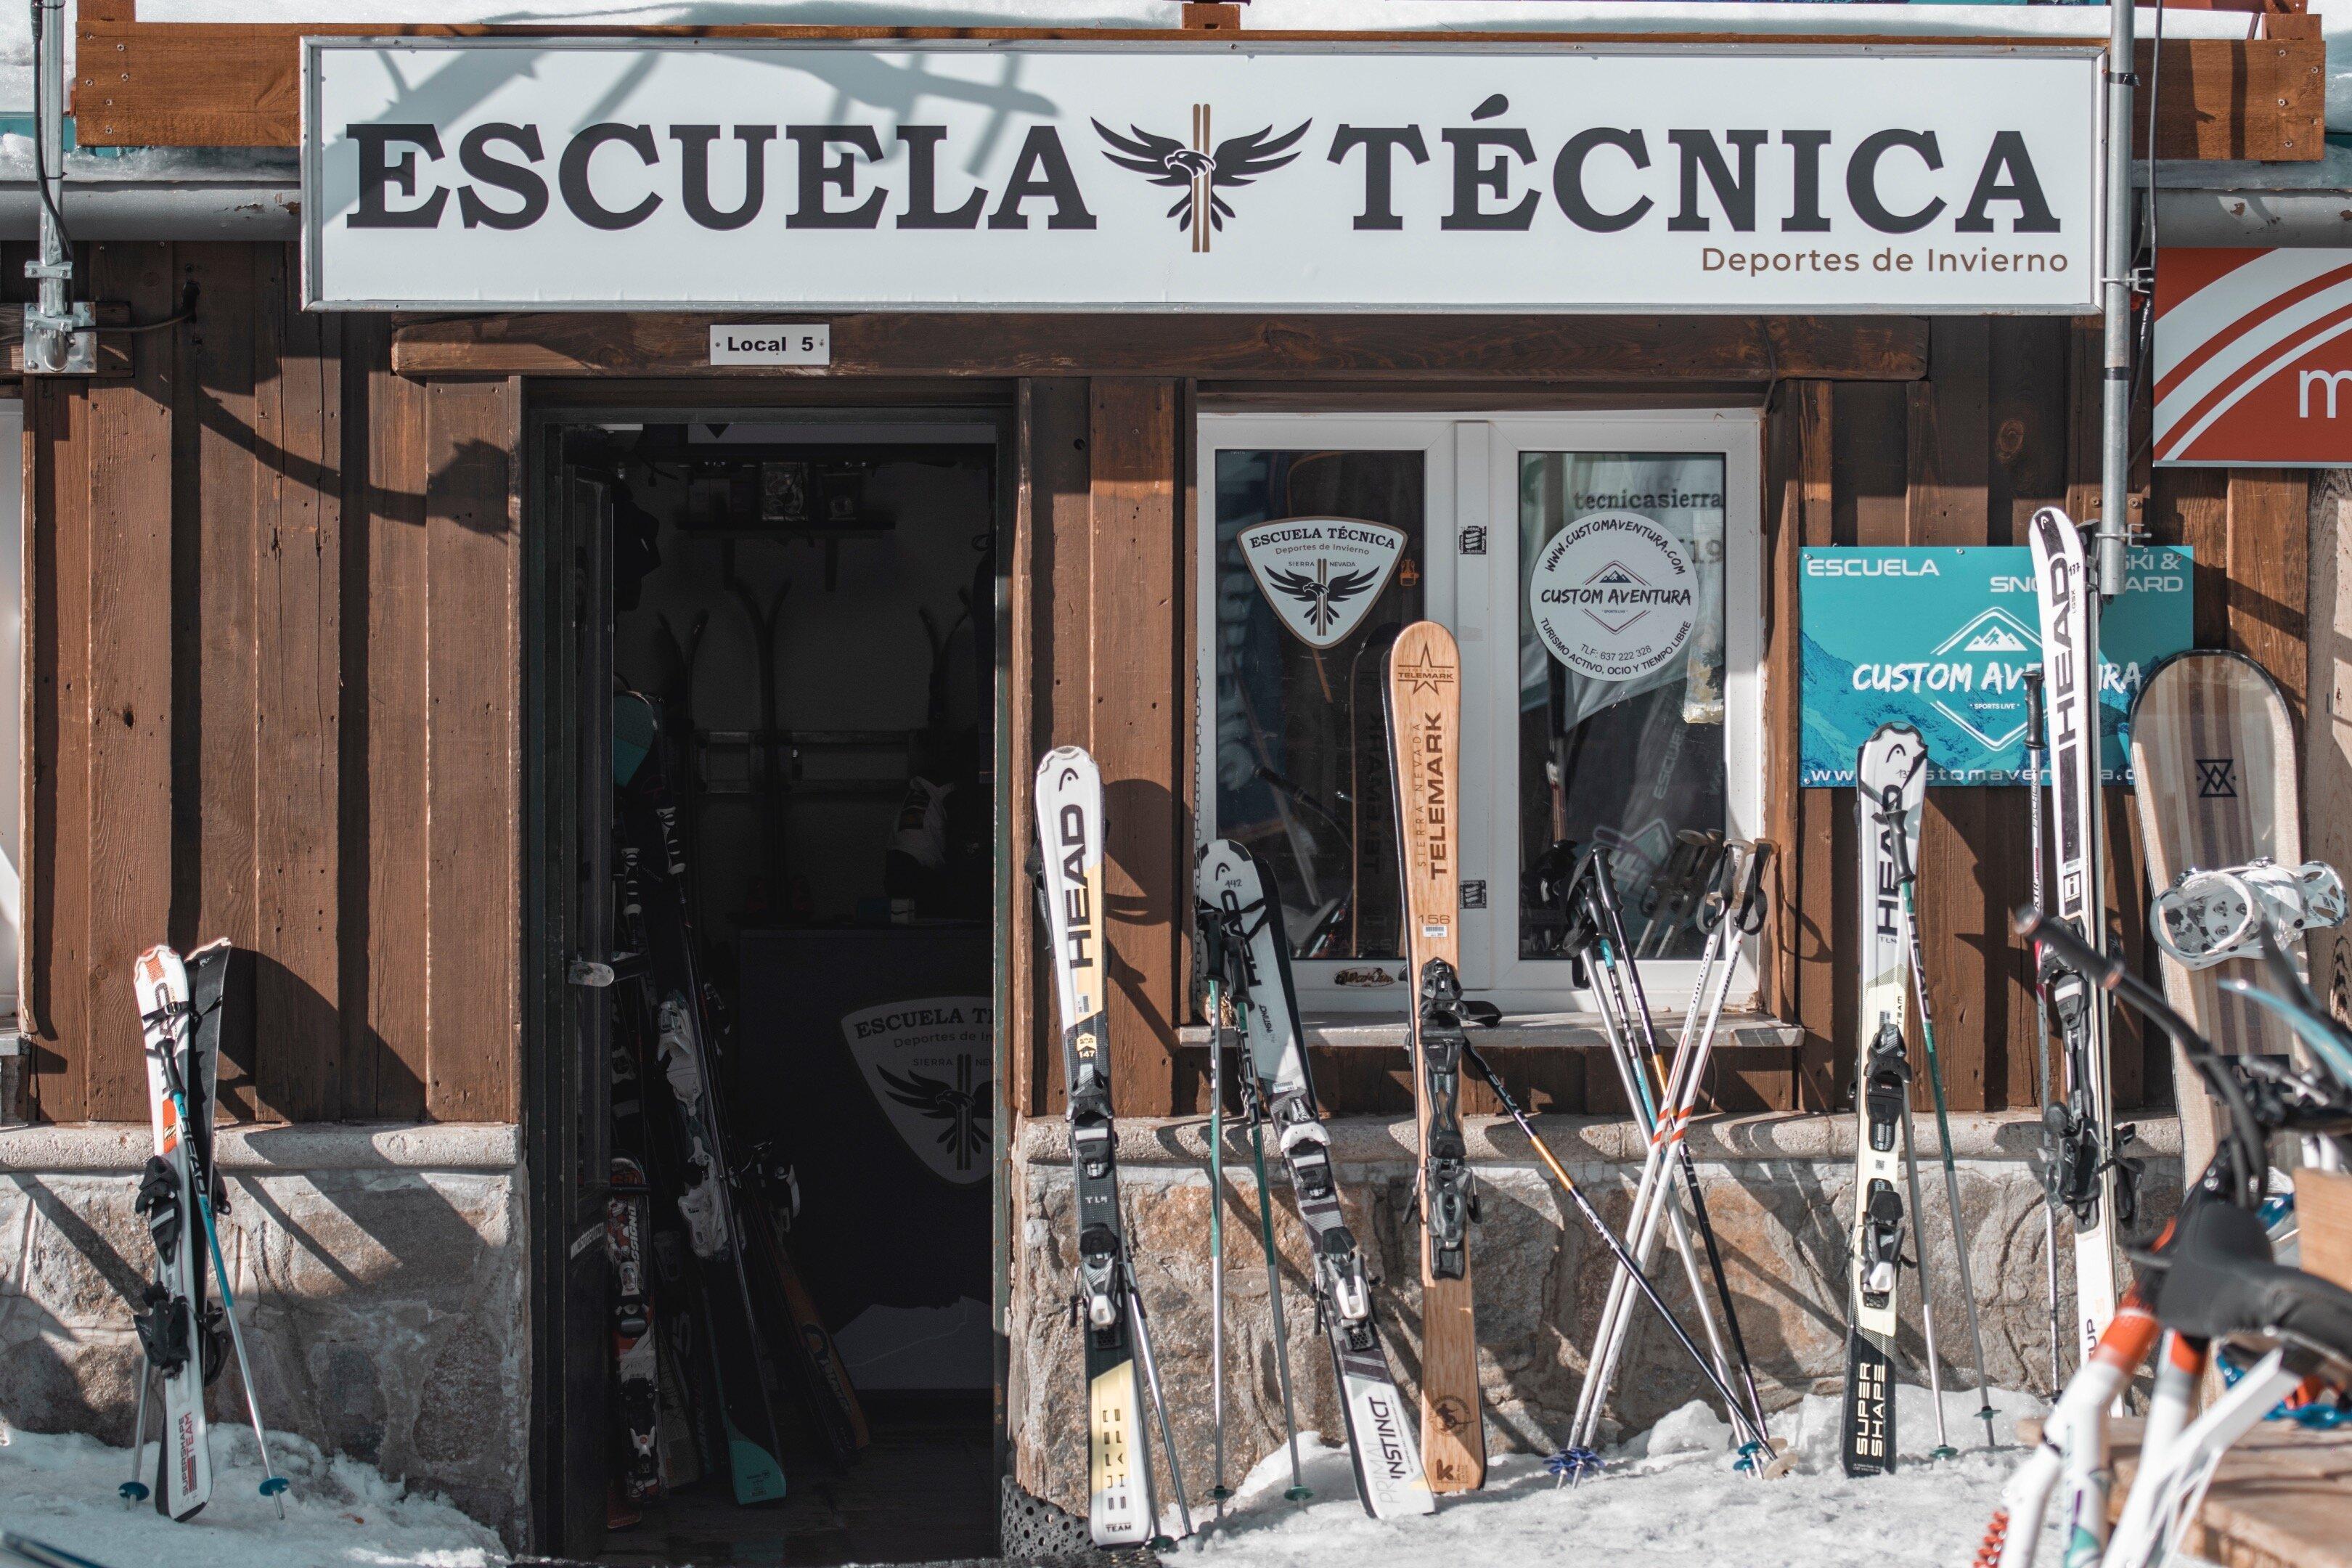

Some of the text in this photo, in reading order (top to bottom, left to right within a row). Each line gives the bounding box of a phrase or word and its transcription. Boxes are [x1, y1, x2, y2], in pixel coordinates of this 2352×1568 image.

[346, 94, 2061, 233] ESCUELA TÉCNICA
[1702, 247, 2068, 277] Deportes de Invierno
[727, 335, 814, 354] Local 5
[1249, 526, 1395, 550] ESCUELA TÉCNICA
[1275, 544, 1317, 555] Deportes
[1333, 544, 1370, 555] Invierno
[1544, 519, 1686, 576] WWW.CUSTOMAVENTURA.COM
[1807, 559, 1940, 576] ESCUELA
[2160, 554, 2181, 570] &
[1540, 589, 1691, 605] CUSTOM AVENTURA
[1990, 576, 2183, 592] SNARD
[1540, 617, 1569, 656] TURISMO
[1607, 666, 1632, 675] OCIO
[1633, 664, 1640, 673] Y
[1641, 646, 1673, 671] TIEMPO
[1671, 621, 1691, 648] LIBRE
[2049, 552, 2077, 745] HEAD
[1853, 661, 1970, 694] CUSTOM
[1895, 769, 1911, 779] 13
[1411, 723, 1426, 867] SIERRA NEVADA
[1424, 711, 1447, 881] TELEMARK
[1061, 804, 1093, 971] HEAD
[1225, 878, 1243, 888] 142
[1418, 915, 1450, 924] 156
[854, 1008, 964, 1039] ESCUELA
[894, 1032, 958, 1048] Deportes
[960, 1031, 976, 1041] de
[1085, 1196, 1108, 1204] TLM
[1855, 1362, 1871, 1455] SUPER
[1871, 1364, 1885, 1458] SHAPE
[184, 1412, 195, 1459] TEAM
[1368, 1396, 1406, 1479] INSTINCT
[178, 1416, 189, 1496] SUPERSHAPE
[1106, 1524, 1132, 1533] TEAM
